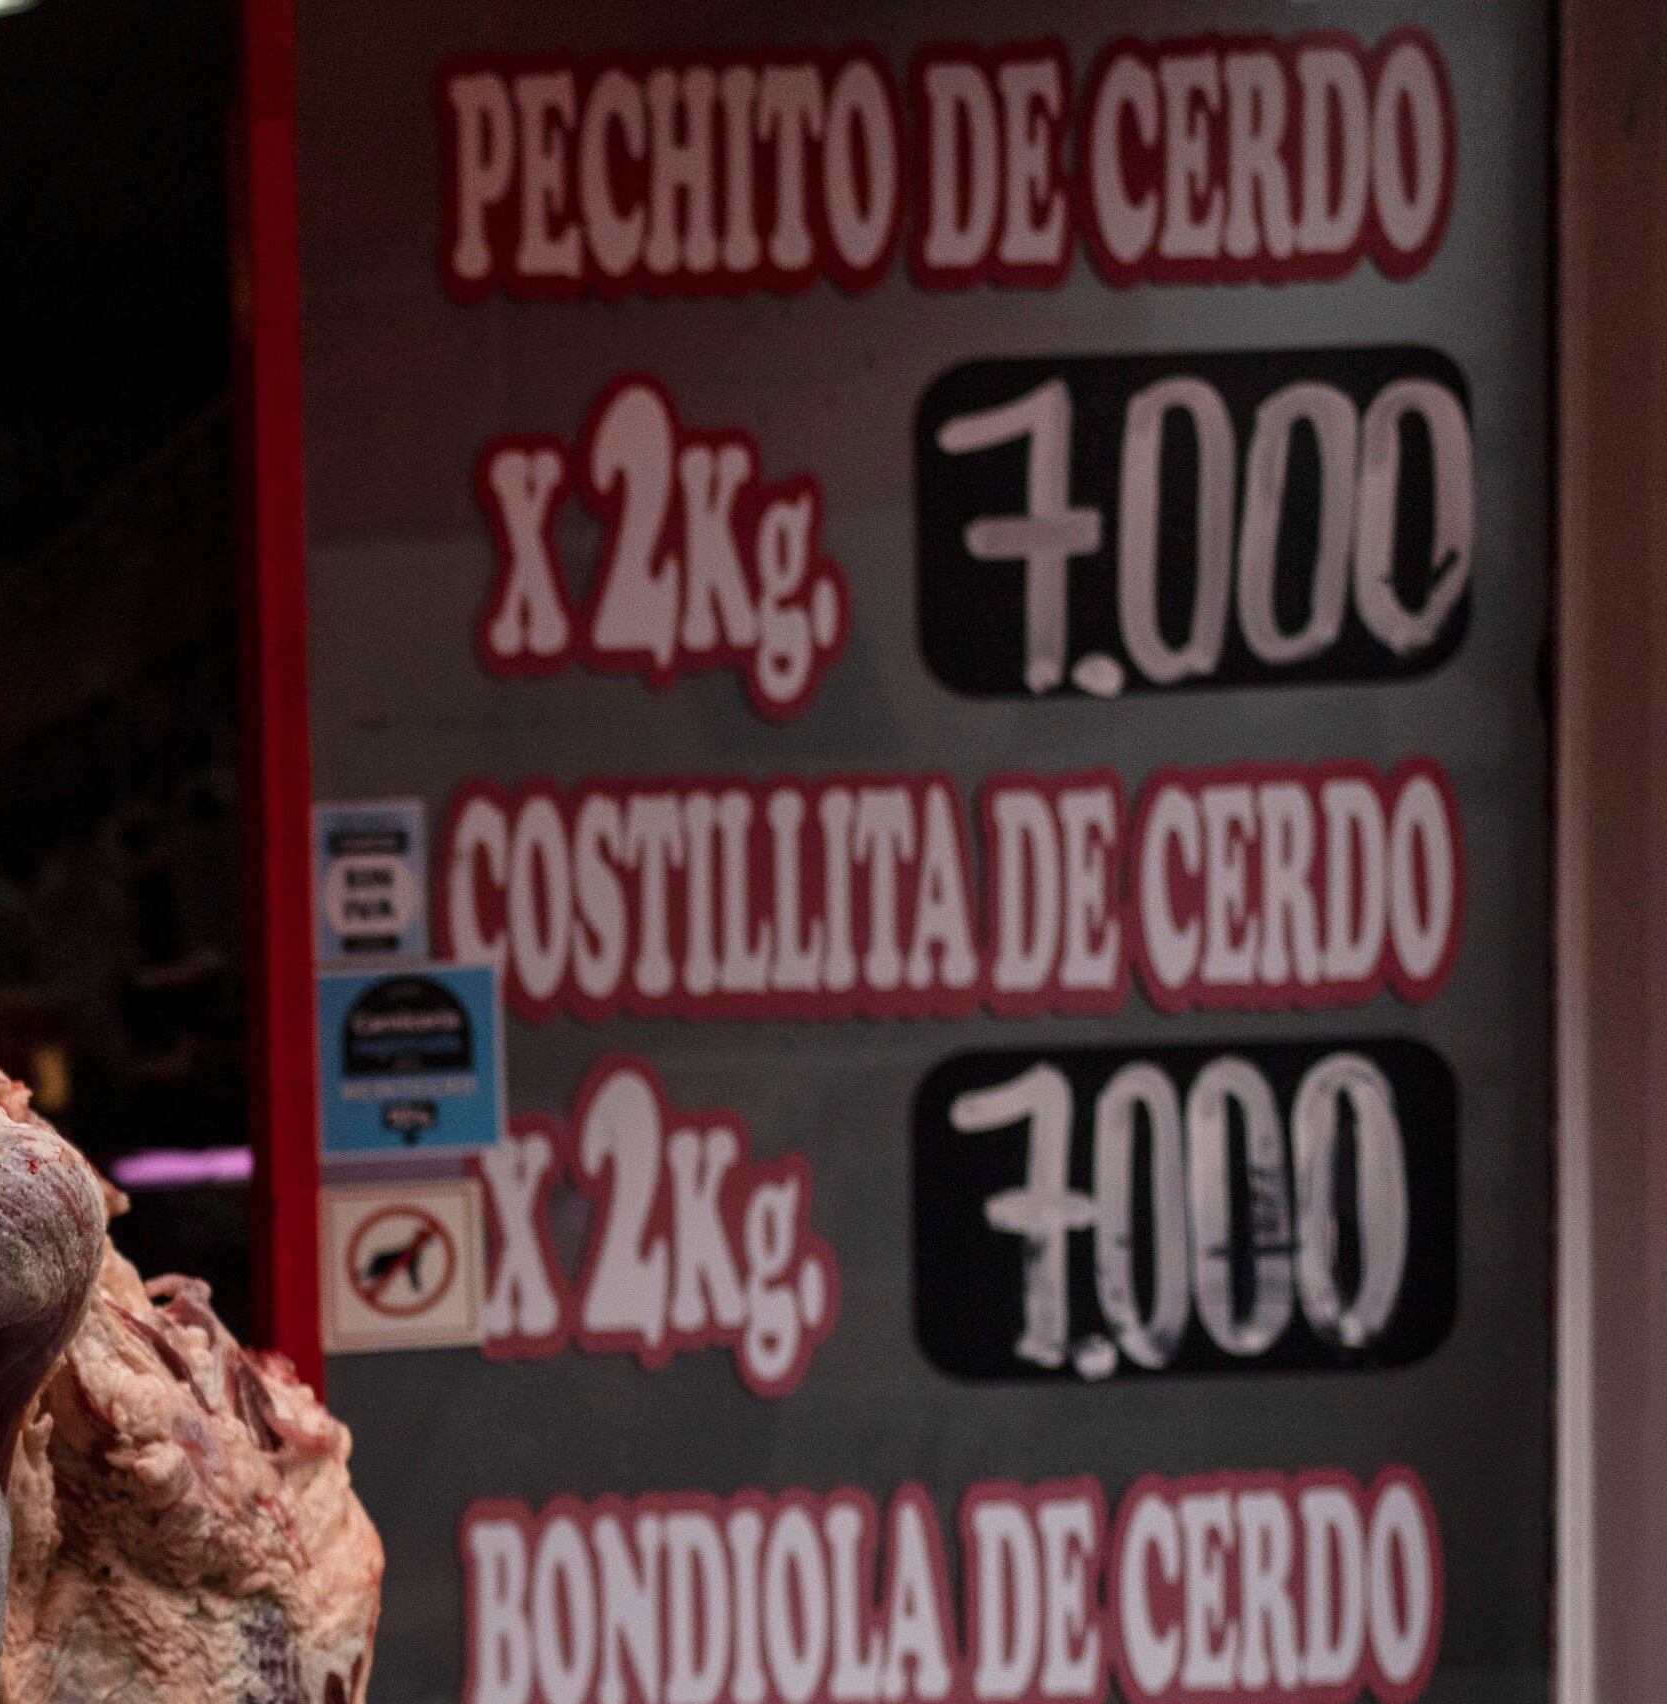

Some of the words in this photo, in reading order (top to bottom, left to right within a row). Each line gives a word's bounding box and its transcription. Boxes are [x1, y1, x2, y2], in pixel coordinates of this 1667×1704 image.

[447, 60, 896, 276] PECHITO
[925, 57, 1063, 266] DE
[1089, 42, 1446, 262] CERDO
[937, 377, 1470, 695] 7.000
[451, 788, 976, 997] COSTILLITA
[994, 788, 1118, 990] DE
[1144, 777, 1454, 986] CERDO
[972, 1499, 1100, 1696] DE
[1120, 1482, 1434, 1693] CERDO
